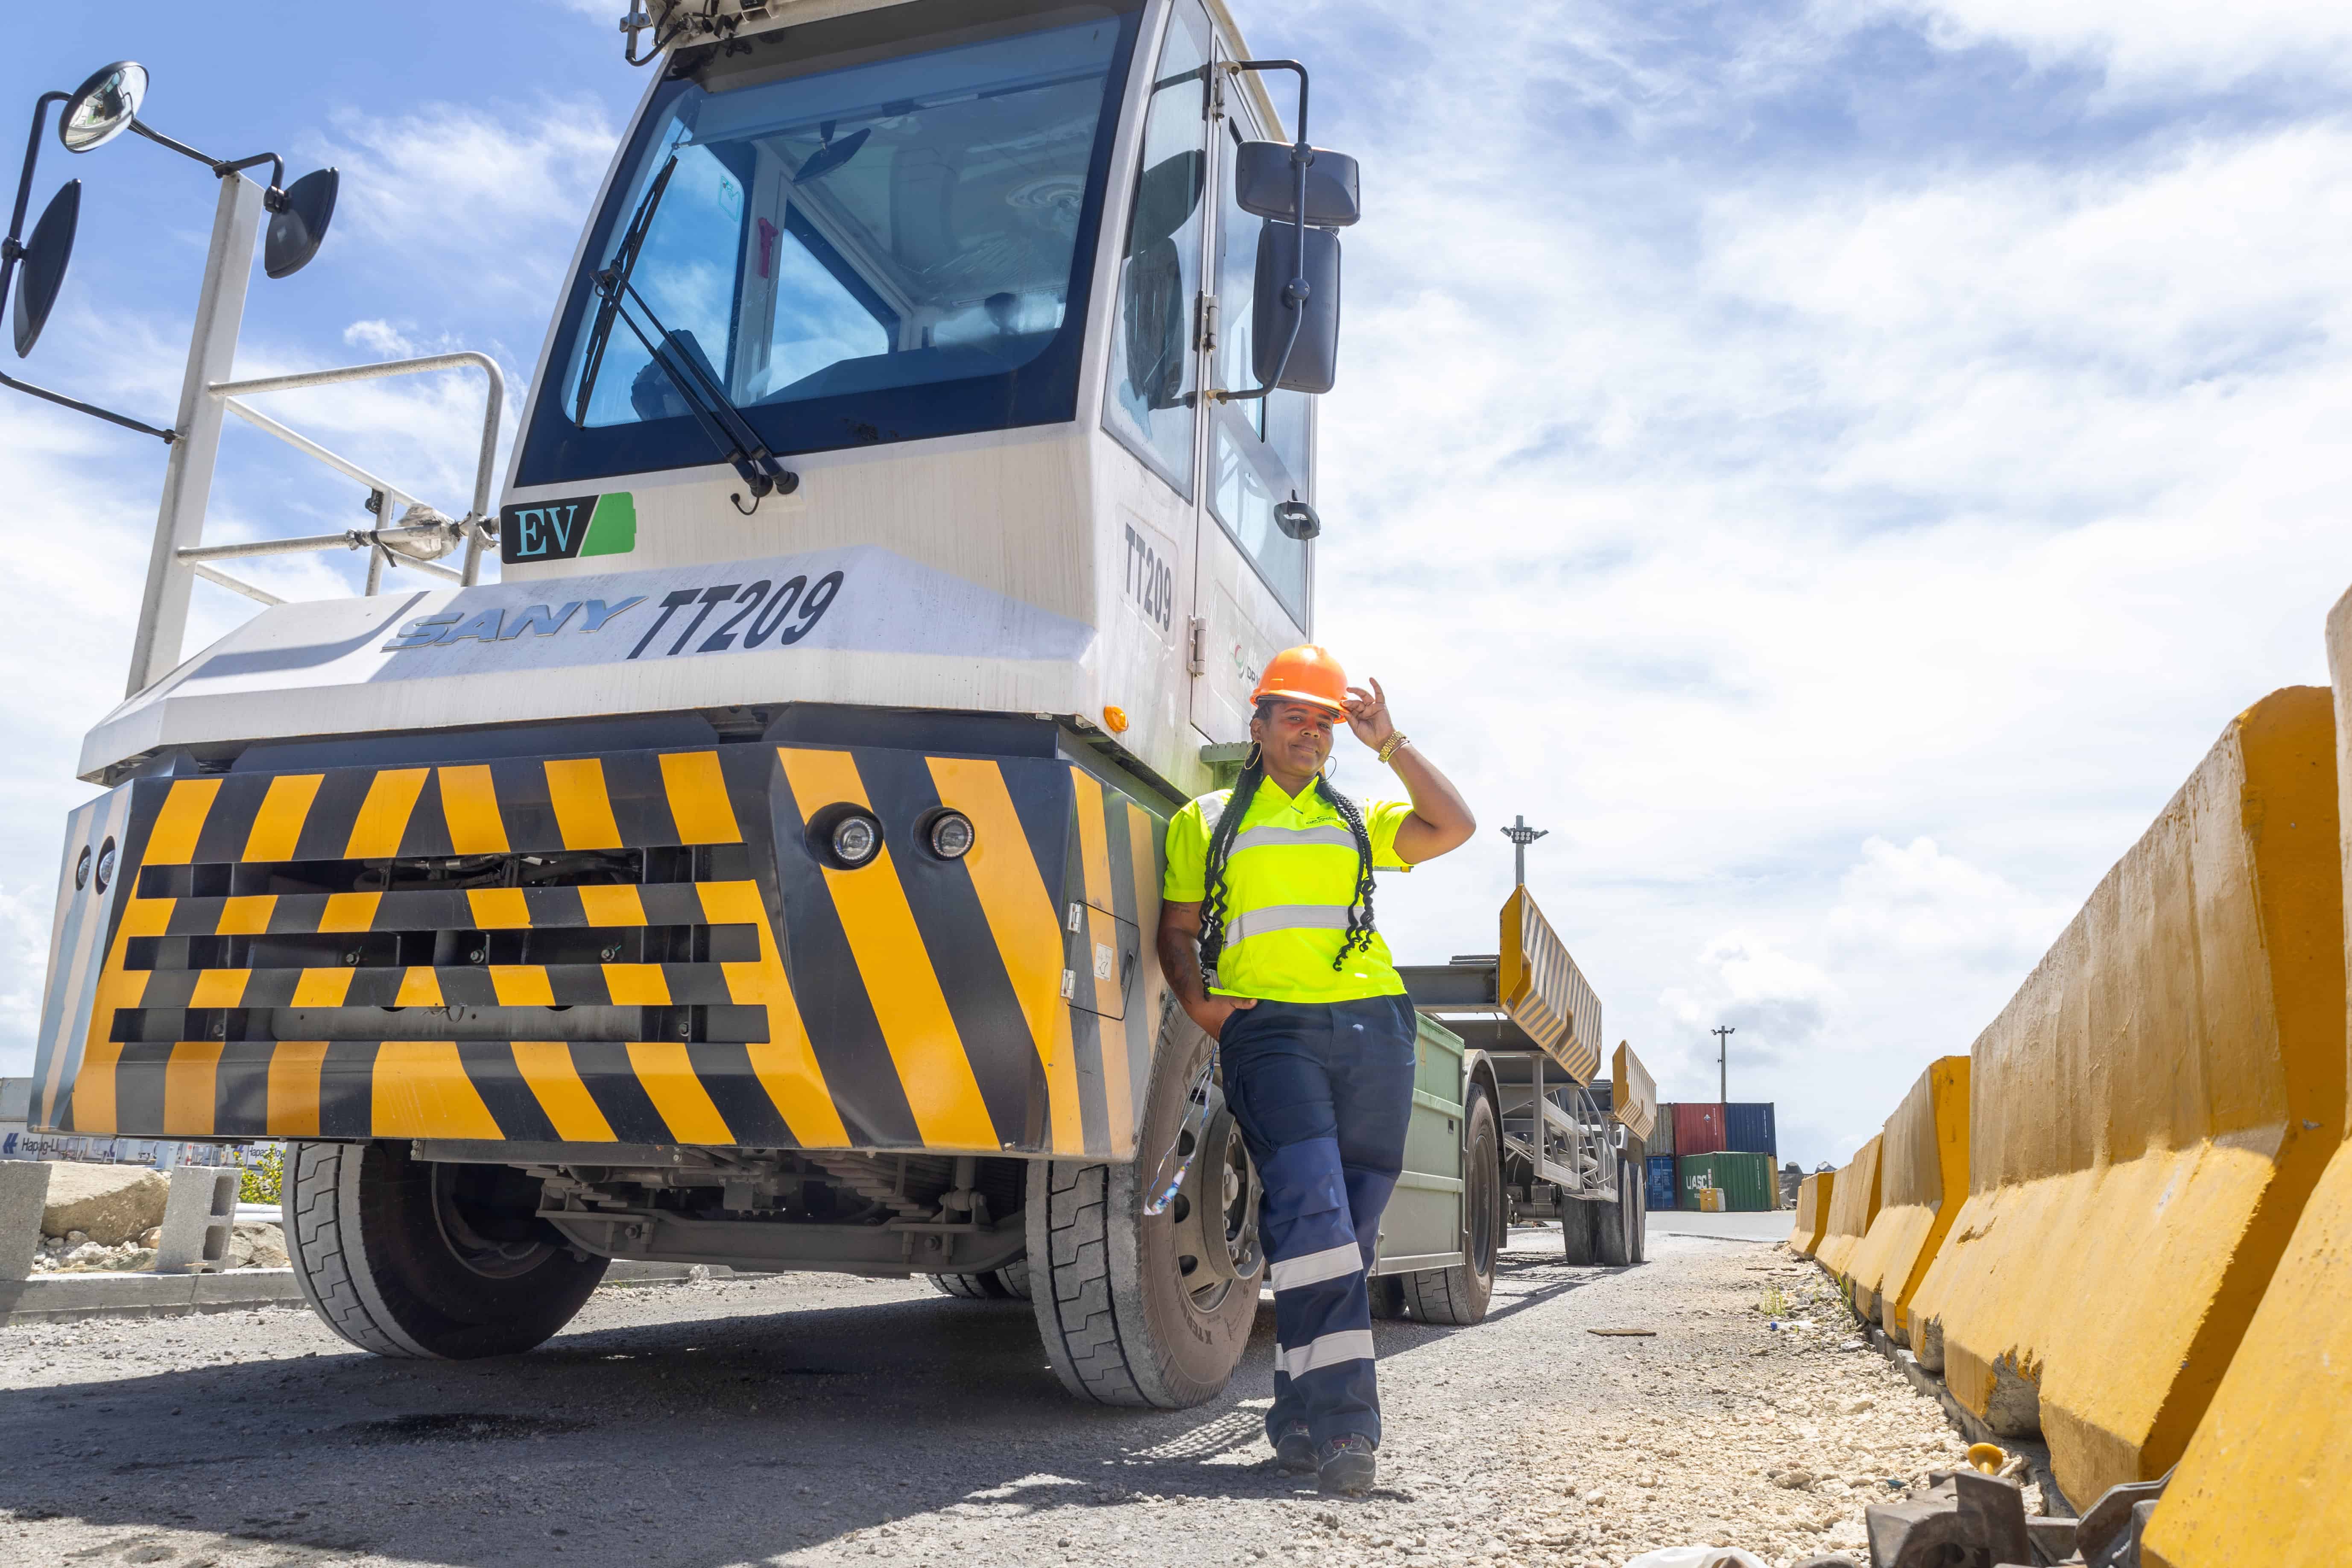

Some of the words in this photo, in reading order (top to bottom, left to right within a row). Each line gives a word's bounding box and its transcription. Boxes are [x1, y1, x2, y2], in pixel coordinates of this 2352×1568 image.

[515, 505, 578, 556] EV
[1125, 522, 1172, 632] TT209
[380, 596, 649, 653] SANY
[626, 570, 845, 660] TT209
[1686, 1175, 1707, 1190] UASC
